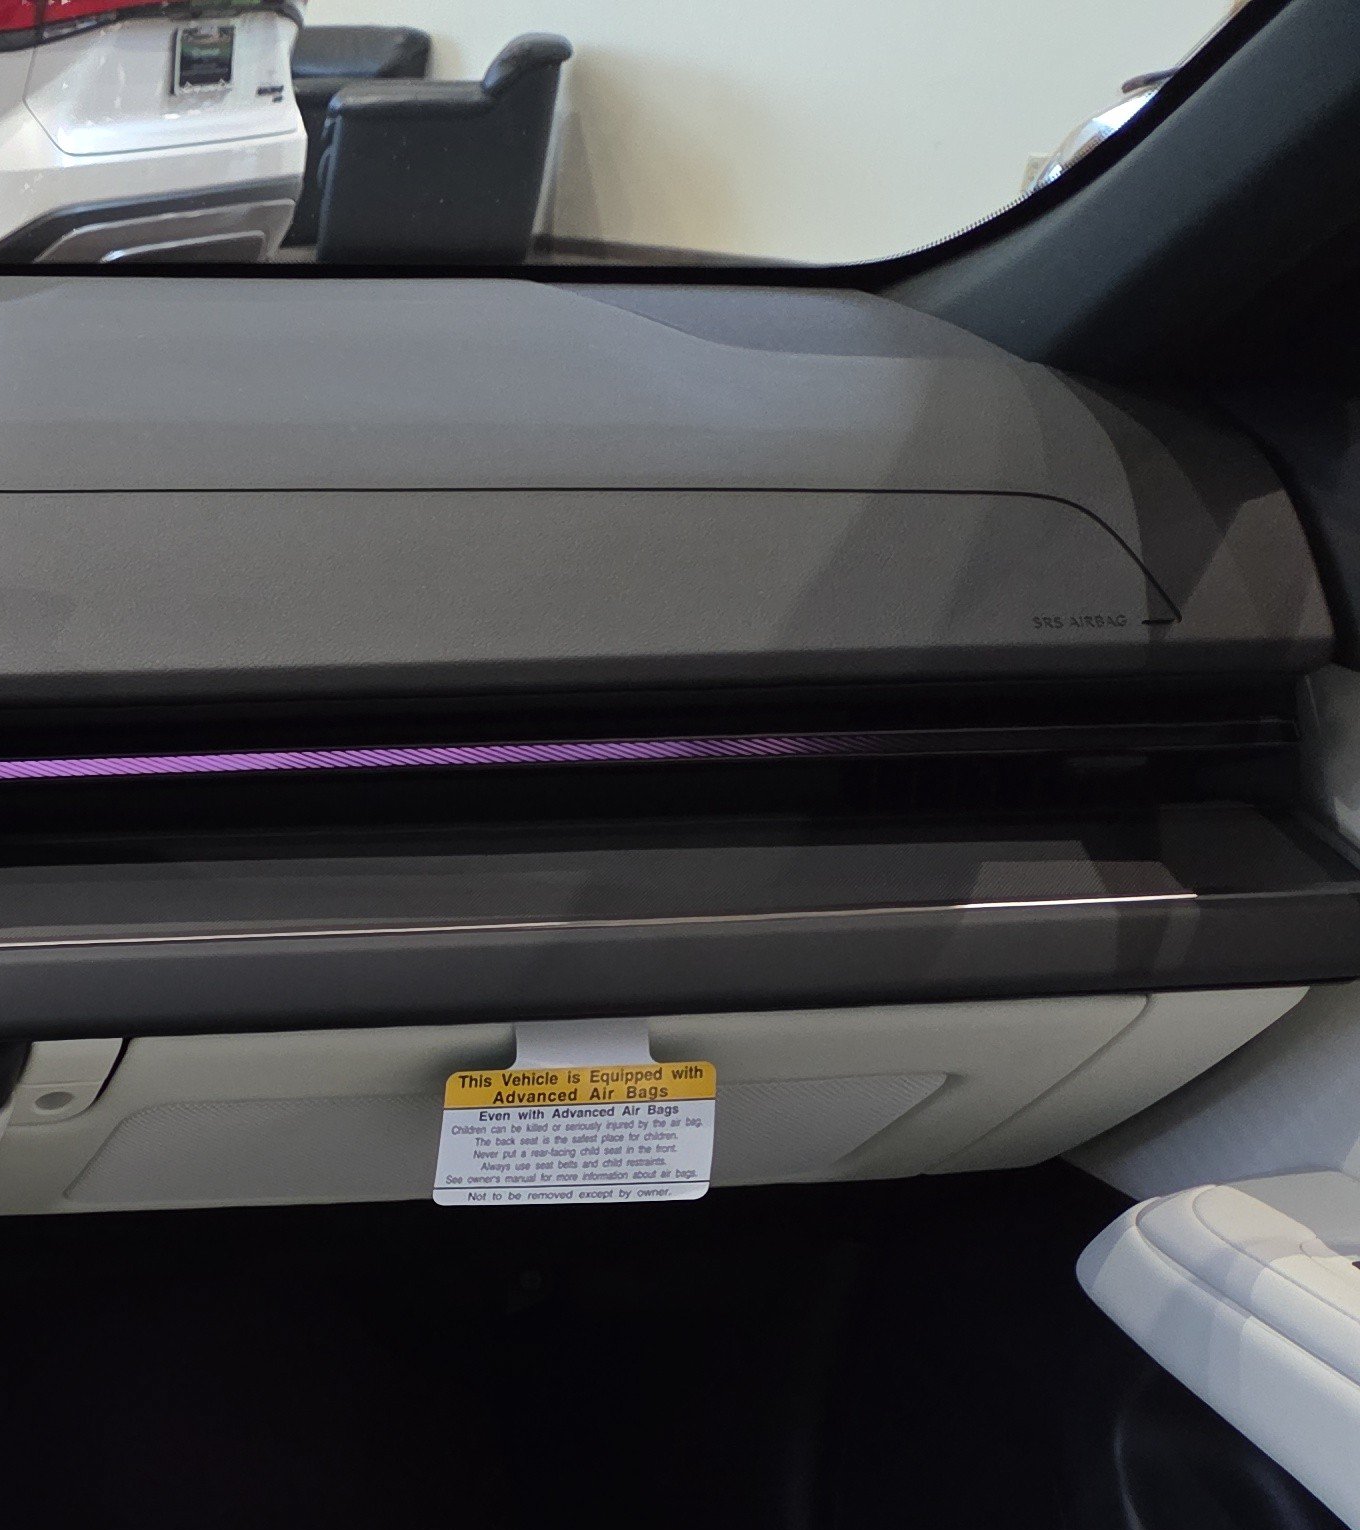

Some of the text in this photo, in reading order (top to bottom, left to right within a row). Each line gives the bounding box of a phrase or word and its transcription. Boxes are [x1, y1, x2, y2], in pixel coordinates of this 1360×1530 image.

[1032, 614, 1128, 629] SRS AIRBAG
[458, 1066, 704, 1089] This Vehicle is Equipped with
[492, 1085, 668, 1104] Advanced Air Bags
[479, 1104, 679, 1121] Even with Advanced Air Bags
[451, 1124, 486, 1135] Children
[491, 1125, 506, 1134] can
[511, 1123, 522, 1133] be
[526, 1123, 548, 1132] killed
[552, 1124, 561, 1132] or
[565, 1121, 602, 1132] seriously
[606, 1119, 634, 1131] injured
[638, 1119, 649, 1130] by
[653, 1118, 666, 1128] the
[475, 1137, 491, 1146] The
[495, 1137, 515, 1146] back
[520, 1136, 538, 1145] seat
[542, 1136, 550, 1145] is
[554, 1135, 568, 1144] the
[601, 1133, 624, 1144] place
[628, 1131, 640, 1141] for
[473, 1149, 498, 1159] Never
[503, 1149, 516, 1159] put
[580, 1146, 600, 1156] child
[604, 1146, 622, 1155] seat
[626, 1145, 634, 1154] in
[638, 1144, 652, 1154] the
[480, 1162, 511, 1172] Always
[515, 1162, 531, 1171] use
[535, 1161, 554, 1170] seat
[582, 1159, 598, 1168] and
[602, 1158, 622, 1168] child
[446, 1174, 463, 1184] See
[505, 1173, 537, 1183] manual
[541, 1172, 552, 1182] for
[556, 1173, 578, 1182] more
[633, 1170, 657, 1179] about
[660, 1169, 671, 1178] air
[468, 1188, 672, 1201] Not to be removed except by owner.
